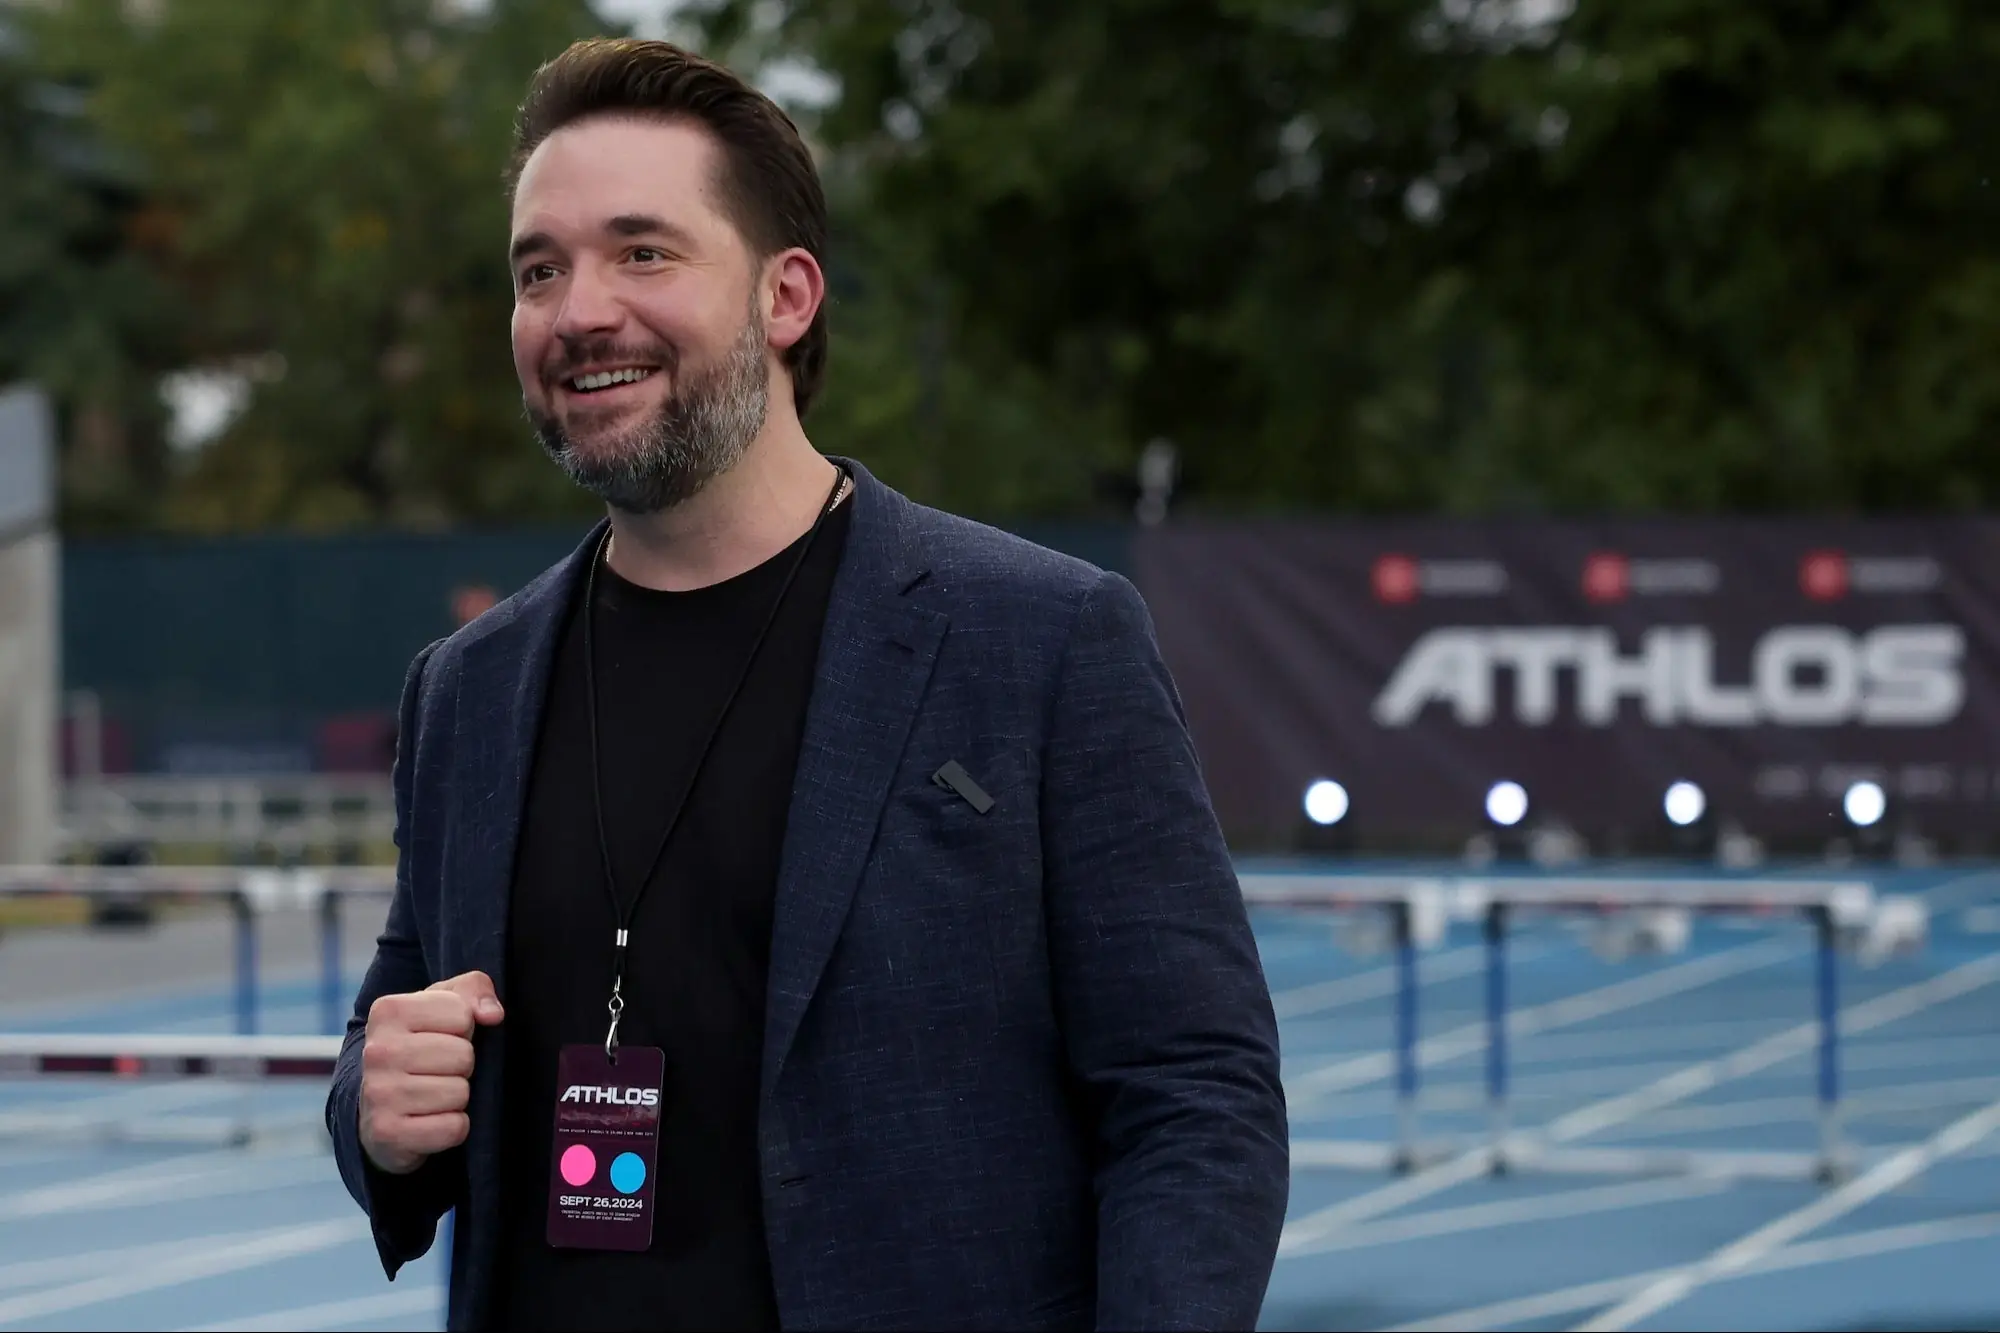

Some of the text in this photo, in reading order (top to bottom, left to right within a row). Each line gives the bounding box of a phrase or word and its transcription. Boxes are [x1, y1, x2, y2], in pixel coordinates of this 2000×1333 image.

[1374, 626, 1964, 726] ATHLOS
[560, 1085, 659, 1106] ATHLOS
[560, 1195, 643, 1209] SEPT 26,2024
